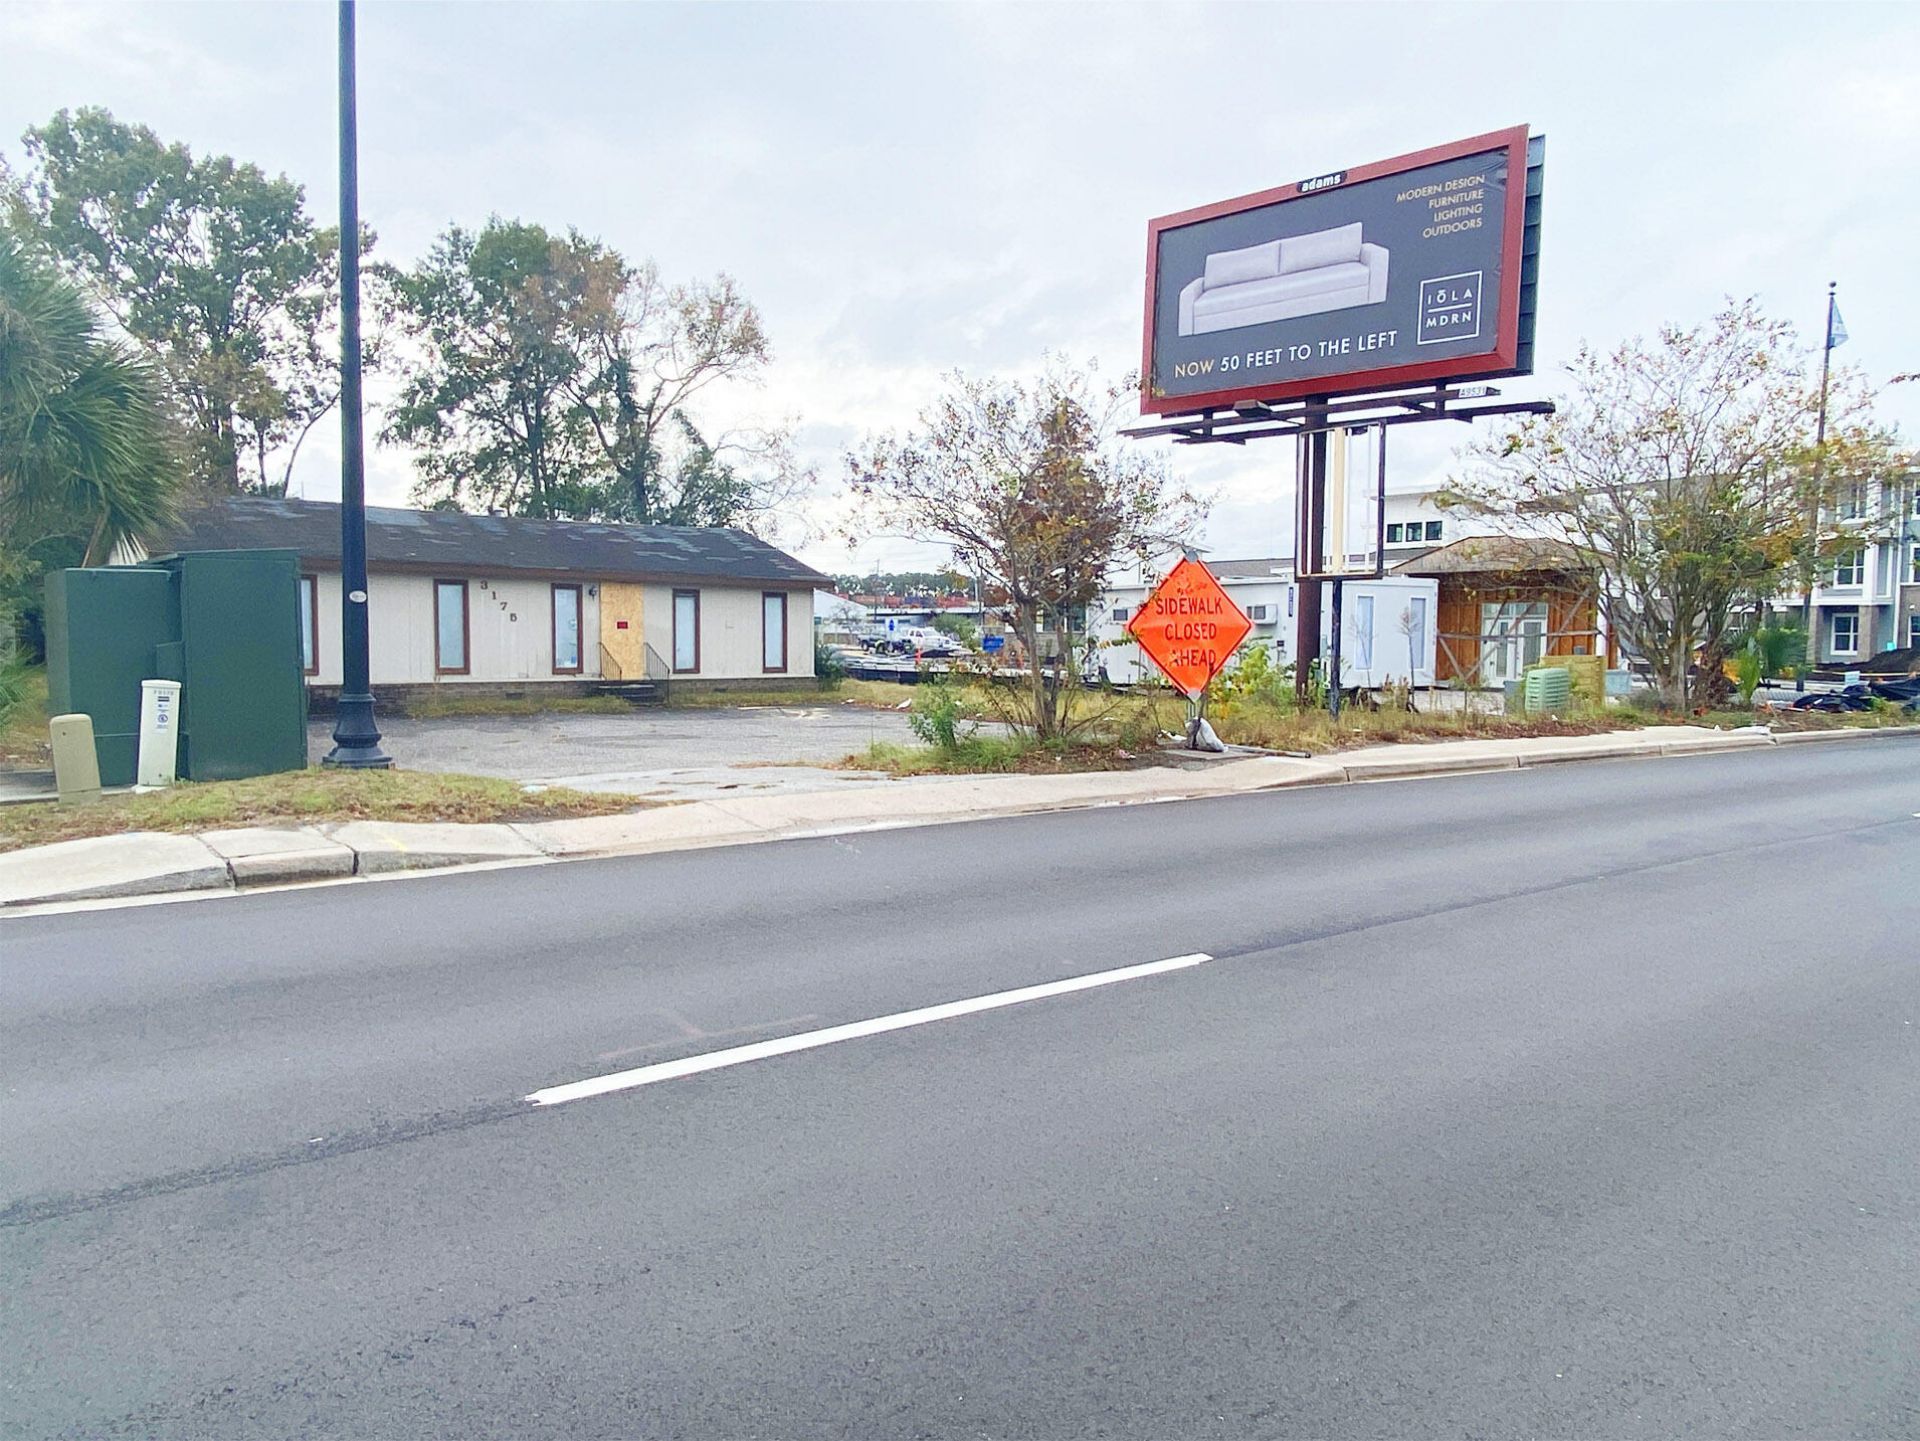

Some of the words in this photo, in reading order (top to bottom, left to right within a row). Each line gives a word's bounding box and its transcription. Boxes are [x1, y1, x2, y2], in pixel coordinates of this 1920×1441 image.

[1301, 174, 1341, 192] adams
[1396, 184, 1442, 202] MODERN
[1445, 174, 1485, 192] DESIGN
[1428, 189, 1484, 209] FURNITURE
[1433, 203, 1483, 222] LIGHTING
[1422, 217, 1482, 238] OUTDOORS
[1426, 311, 1472, 328] MDRN
[1174, 358, 1215, 379] NOW
[1220, 355, 1240, 372] 50
[1246, 348, 1283, 368] FEET
[1288, 344, 1312, 361] TO
[1318, 337, 1351, 357] THE
[1358, 330, 1398, 352] LEFT
[1155, 598, 1223, 615] SIDEWALK
[1165, 623, 1217, 640] CLOSED
